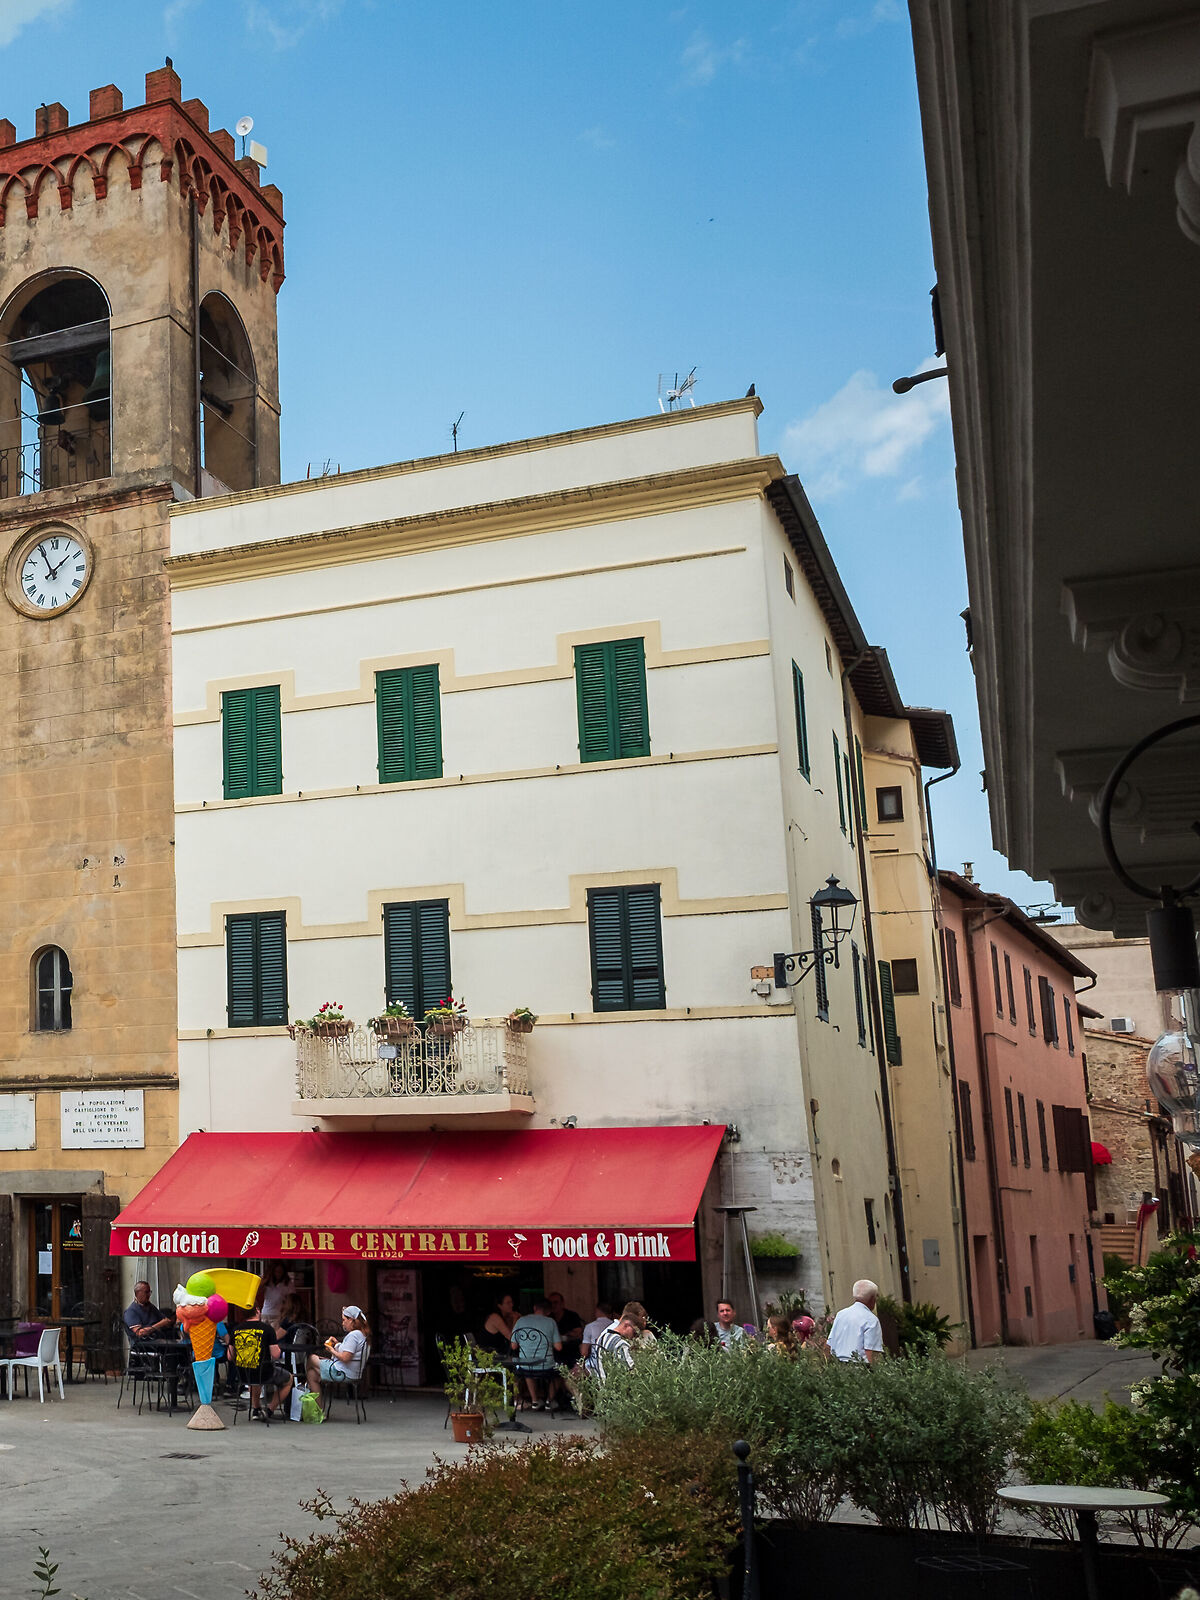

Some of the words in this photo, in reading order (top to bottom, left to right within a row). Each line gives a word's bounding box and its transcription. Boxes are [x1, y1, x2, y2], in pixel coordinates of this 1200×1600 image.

[28, 559, 38, 567] X
[128, 1230, 220, 1254] Gelateria
[280, 1232, 335, 1250] BAR
[350, 1232, 490, 1251] CENTRALE
[541, 1233, 590, 1258] Food
[593, 1232, 610, 1257] &
[613, 1232, 671, 1257] Drink
